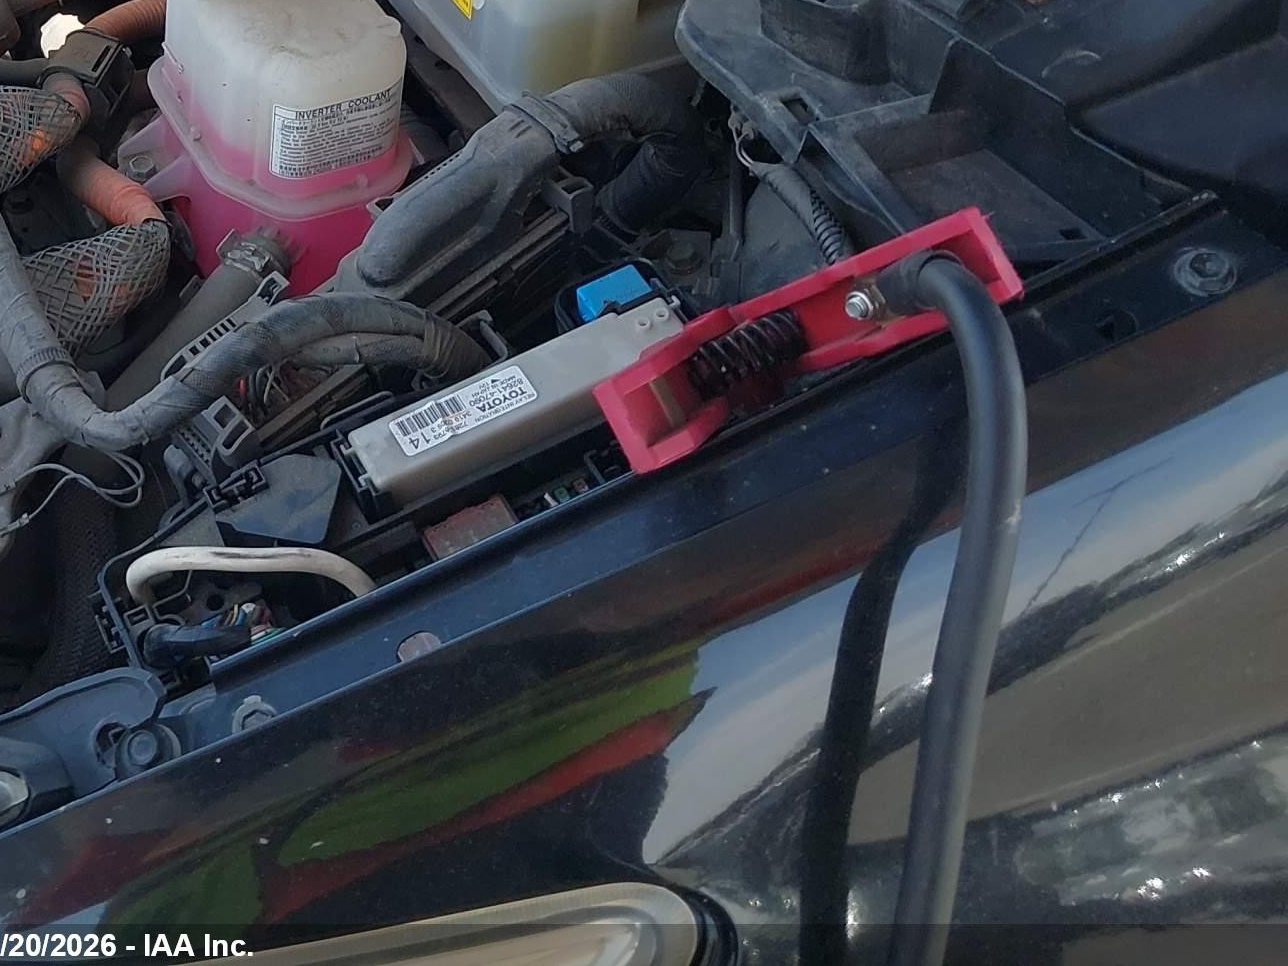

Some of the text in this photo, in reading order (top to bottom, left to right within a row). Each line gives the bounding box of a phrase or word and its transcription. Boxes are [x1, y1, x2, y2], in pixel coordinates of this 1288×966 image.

[295, 88, 392, 120] INVERTER COOLANT
[475, 385, 527, 413] TOYOTA
[406, 430, 431, 451] 14
